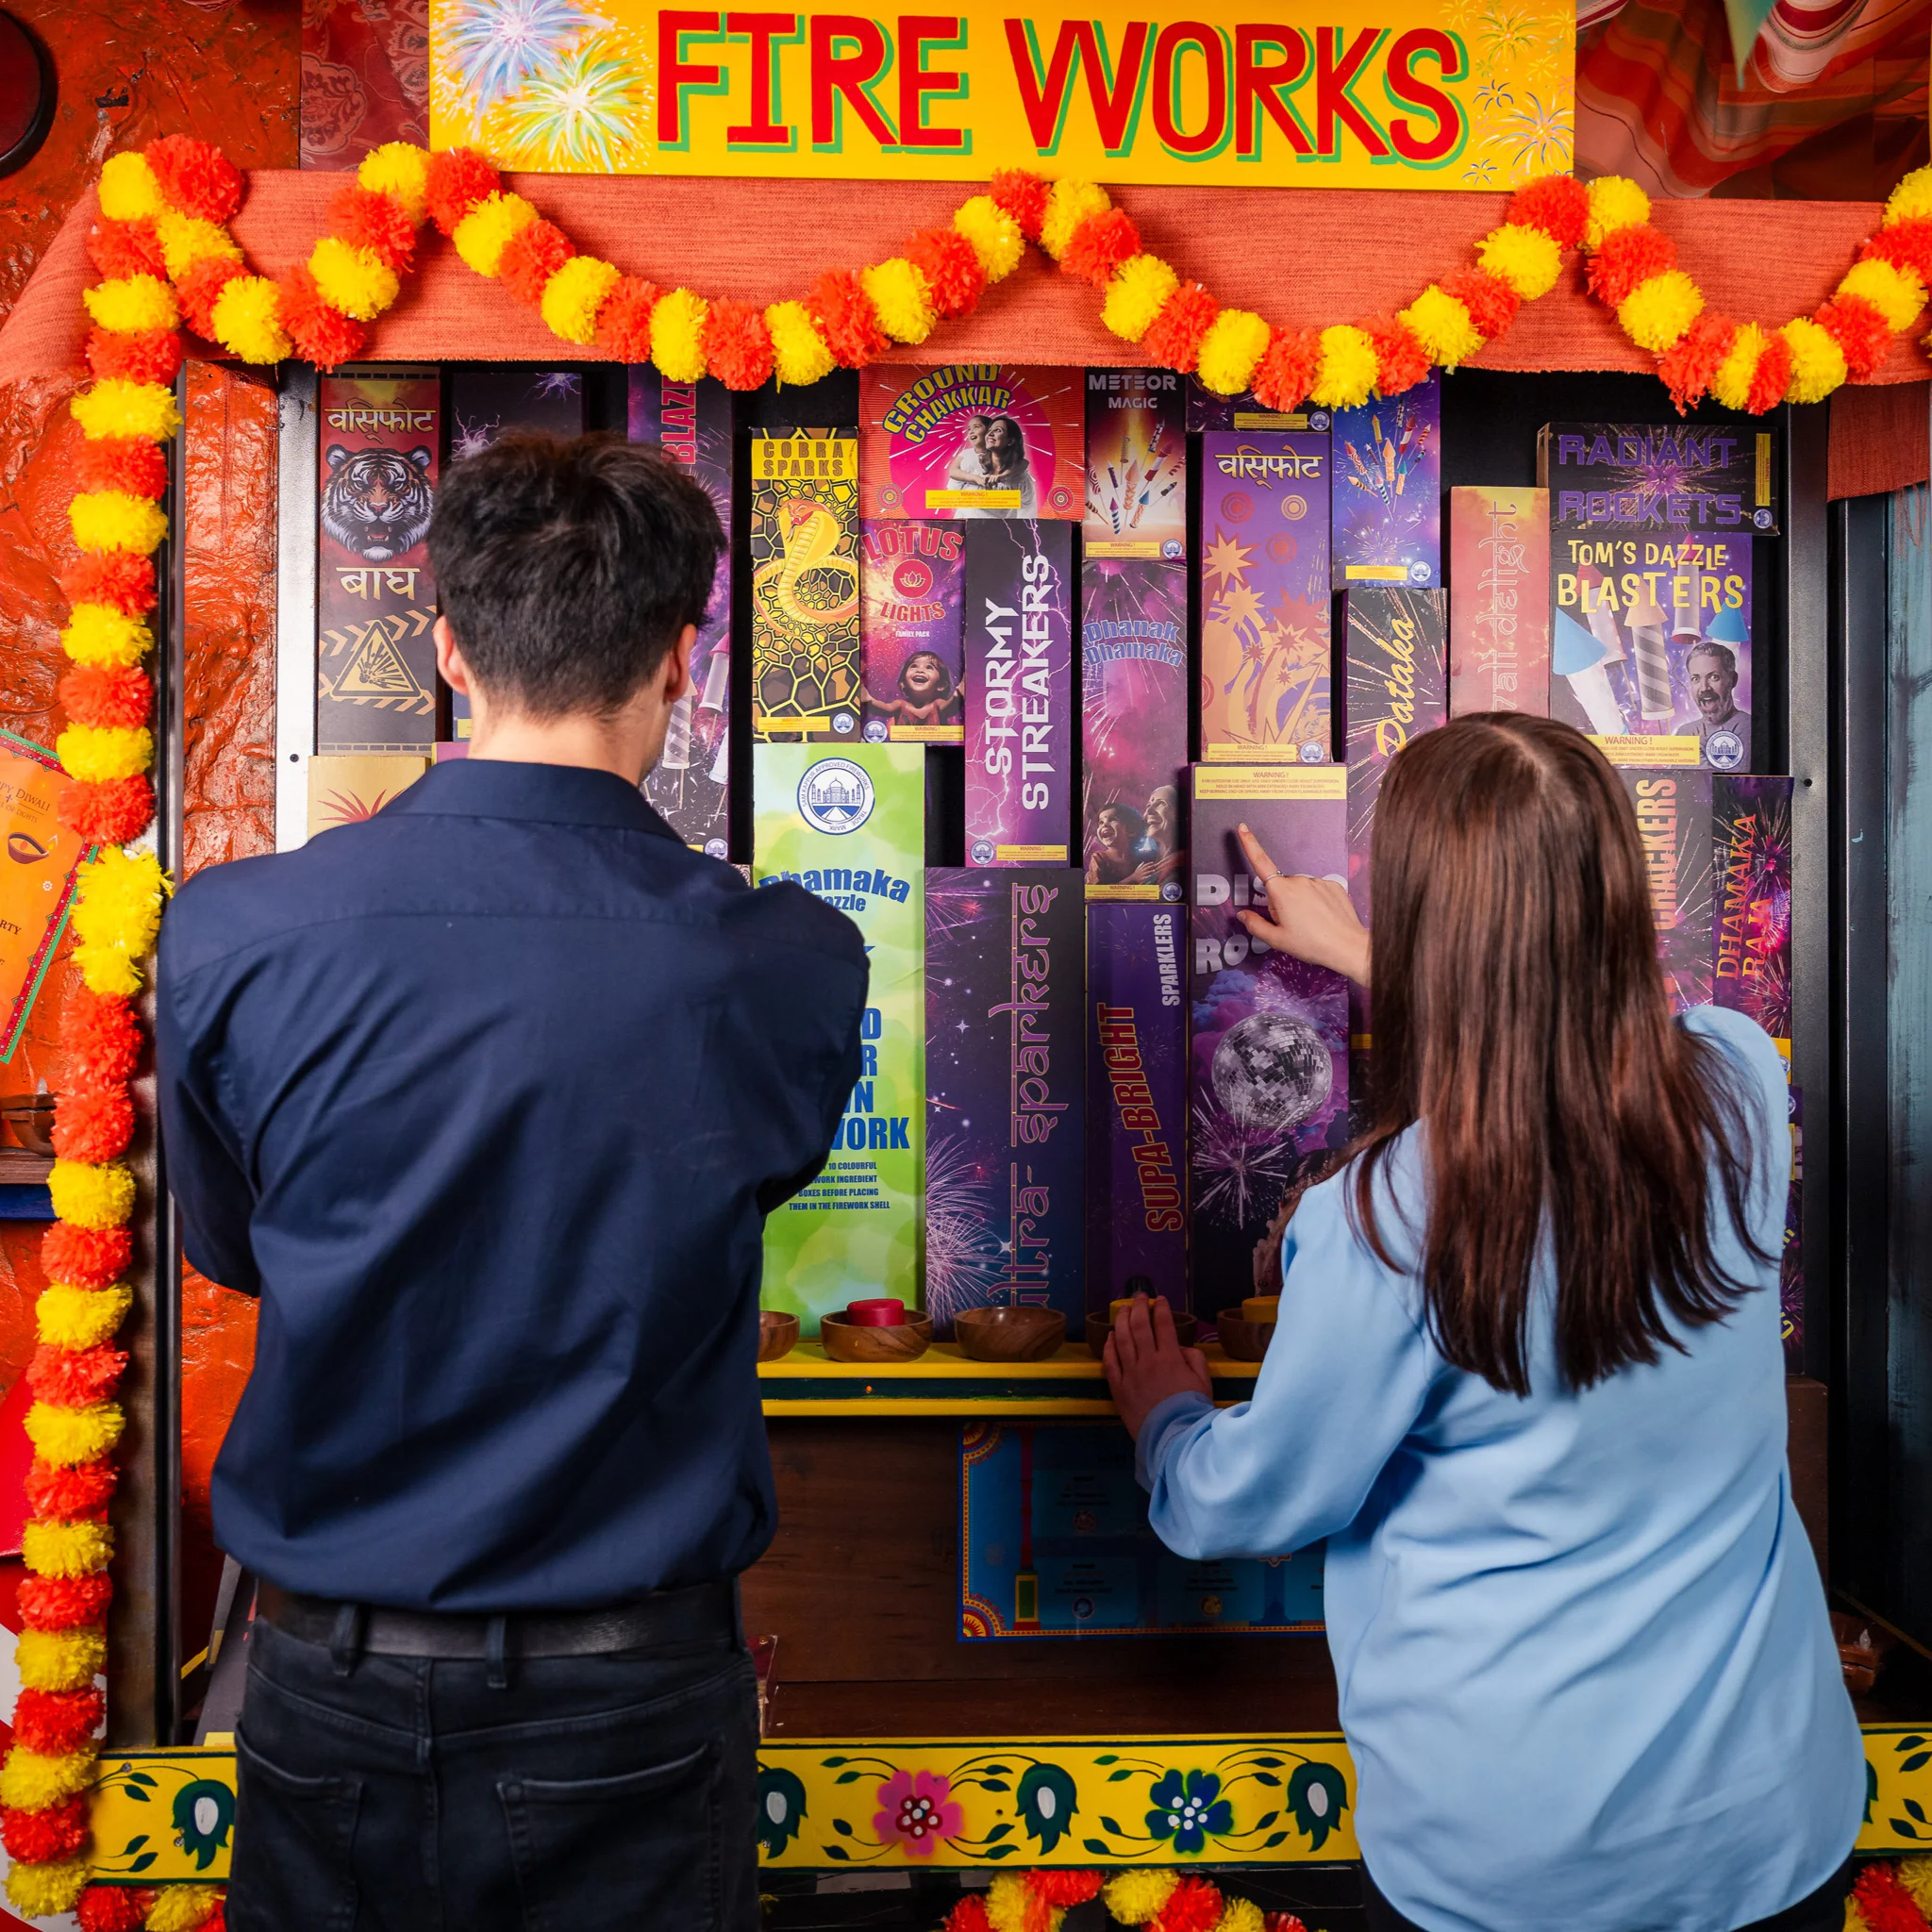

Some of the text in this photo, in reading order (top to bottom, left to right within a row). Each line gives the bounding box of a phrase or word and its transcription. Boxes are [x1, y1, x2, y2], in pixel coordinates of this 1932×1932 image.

[657, 9, 1469, 172] FIRE WORKS
[883, 365, 1000, 434] GROUND
[1089, 375, 1176, 391] METEOR
[904, 384, 1012, 443] CHAKKAR
[1108, 397, 1158, 408] MAGIC
[763, 441, 843, 458] COBRA
[1558, 434, 1737, 469] RADIANT
[763, 459, 843, 476] SPARKS
[1558, 491, 1742, 525] ROCKETS
[860, 525, 963, 561] LOTUS
[1568, 540, 1726, 571] TOM'S DAZZLE
[336, 566, 421, 601] बाघ
[1557, 571, 1744, 614] BLASTERS
[880, 602, 946, 623] LIGHTS
[1084, 620, 1180, 643] Dhanak
[1084, 642, 1183, 668] Dhamaka
[985, 597, 1020, 774] STORMY
[1022, 555, 1057, 810] STREAKERS
[1375, 613, 1415, 758] Pataka
[815, 761, 846, 774] APPROVED
[846, 763, 871, 791] FIREWORKS
[16, 789, 51, 811] DIWALI
[1636, 778, 1677, 931] CRACKERS
[815, 894, 866, 912] zzle
[1716, 814, 1757, 980] DHAMAKA
[1195, 933, 1274, 974] RO
[1741, 897, 1773, 978] RAJA
[1153, 912, 1181, 1007] SPARKLERS
[1097, 1002, 1184, 1232] SUPA-BRIGHT
[811, 1174, 878, 1184] WORK INGREDIENT
[838, 1161, 877, 1170] COLOURFUL
[798, 1188, 878, 1197] BOXES BEFORE PLACING
[832, 1201, 869, 1209] FIREWORK
[870, 1201, 891, 1209] SHELL
